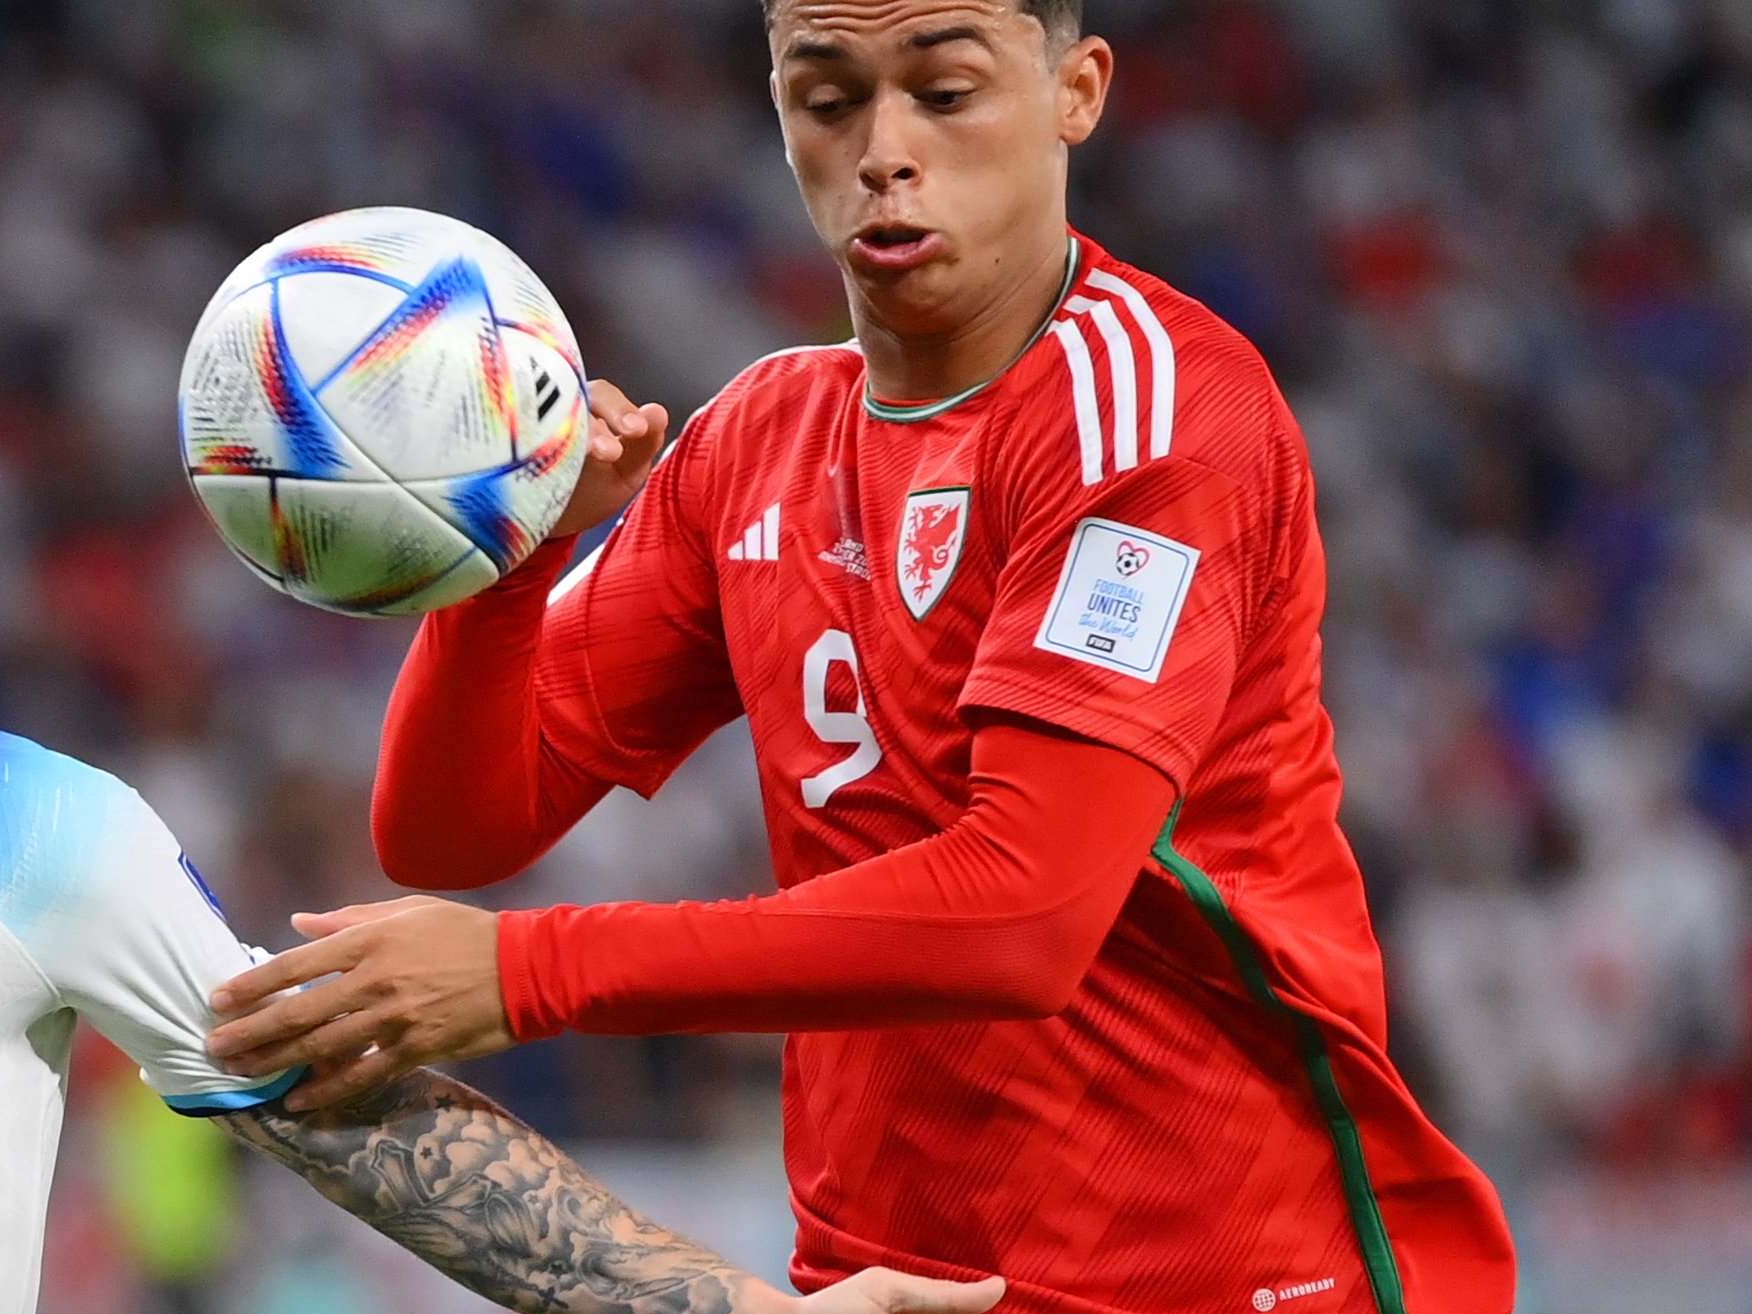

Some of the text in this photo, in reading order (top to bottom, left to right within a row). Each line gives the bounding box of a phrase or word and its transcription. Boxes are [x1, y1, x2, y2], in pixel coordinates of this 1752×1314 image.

[1093, 579, 1144, 606] FOOTBALL
[1087, 593, 1141, 623] UNITES
[801, 629, 882, 808] 9
[1279, 1278, 1335, 1301] AEROREADY
